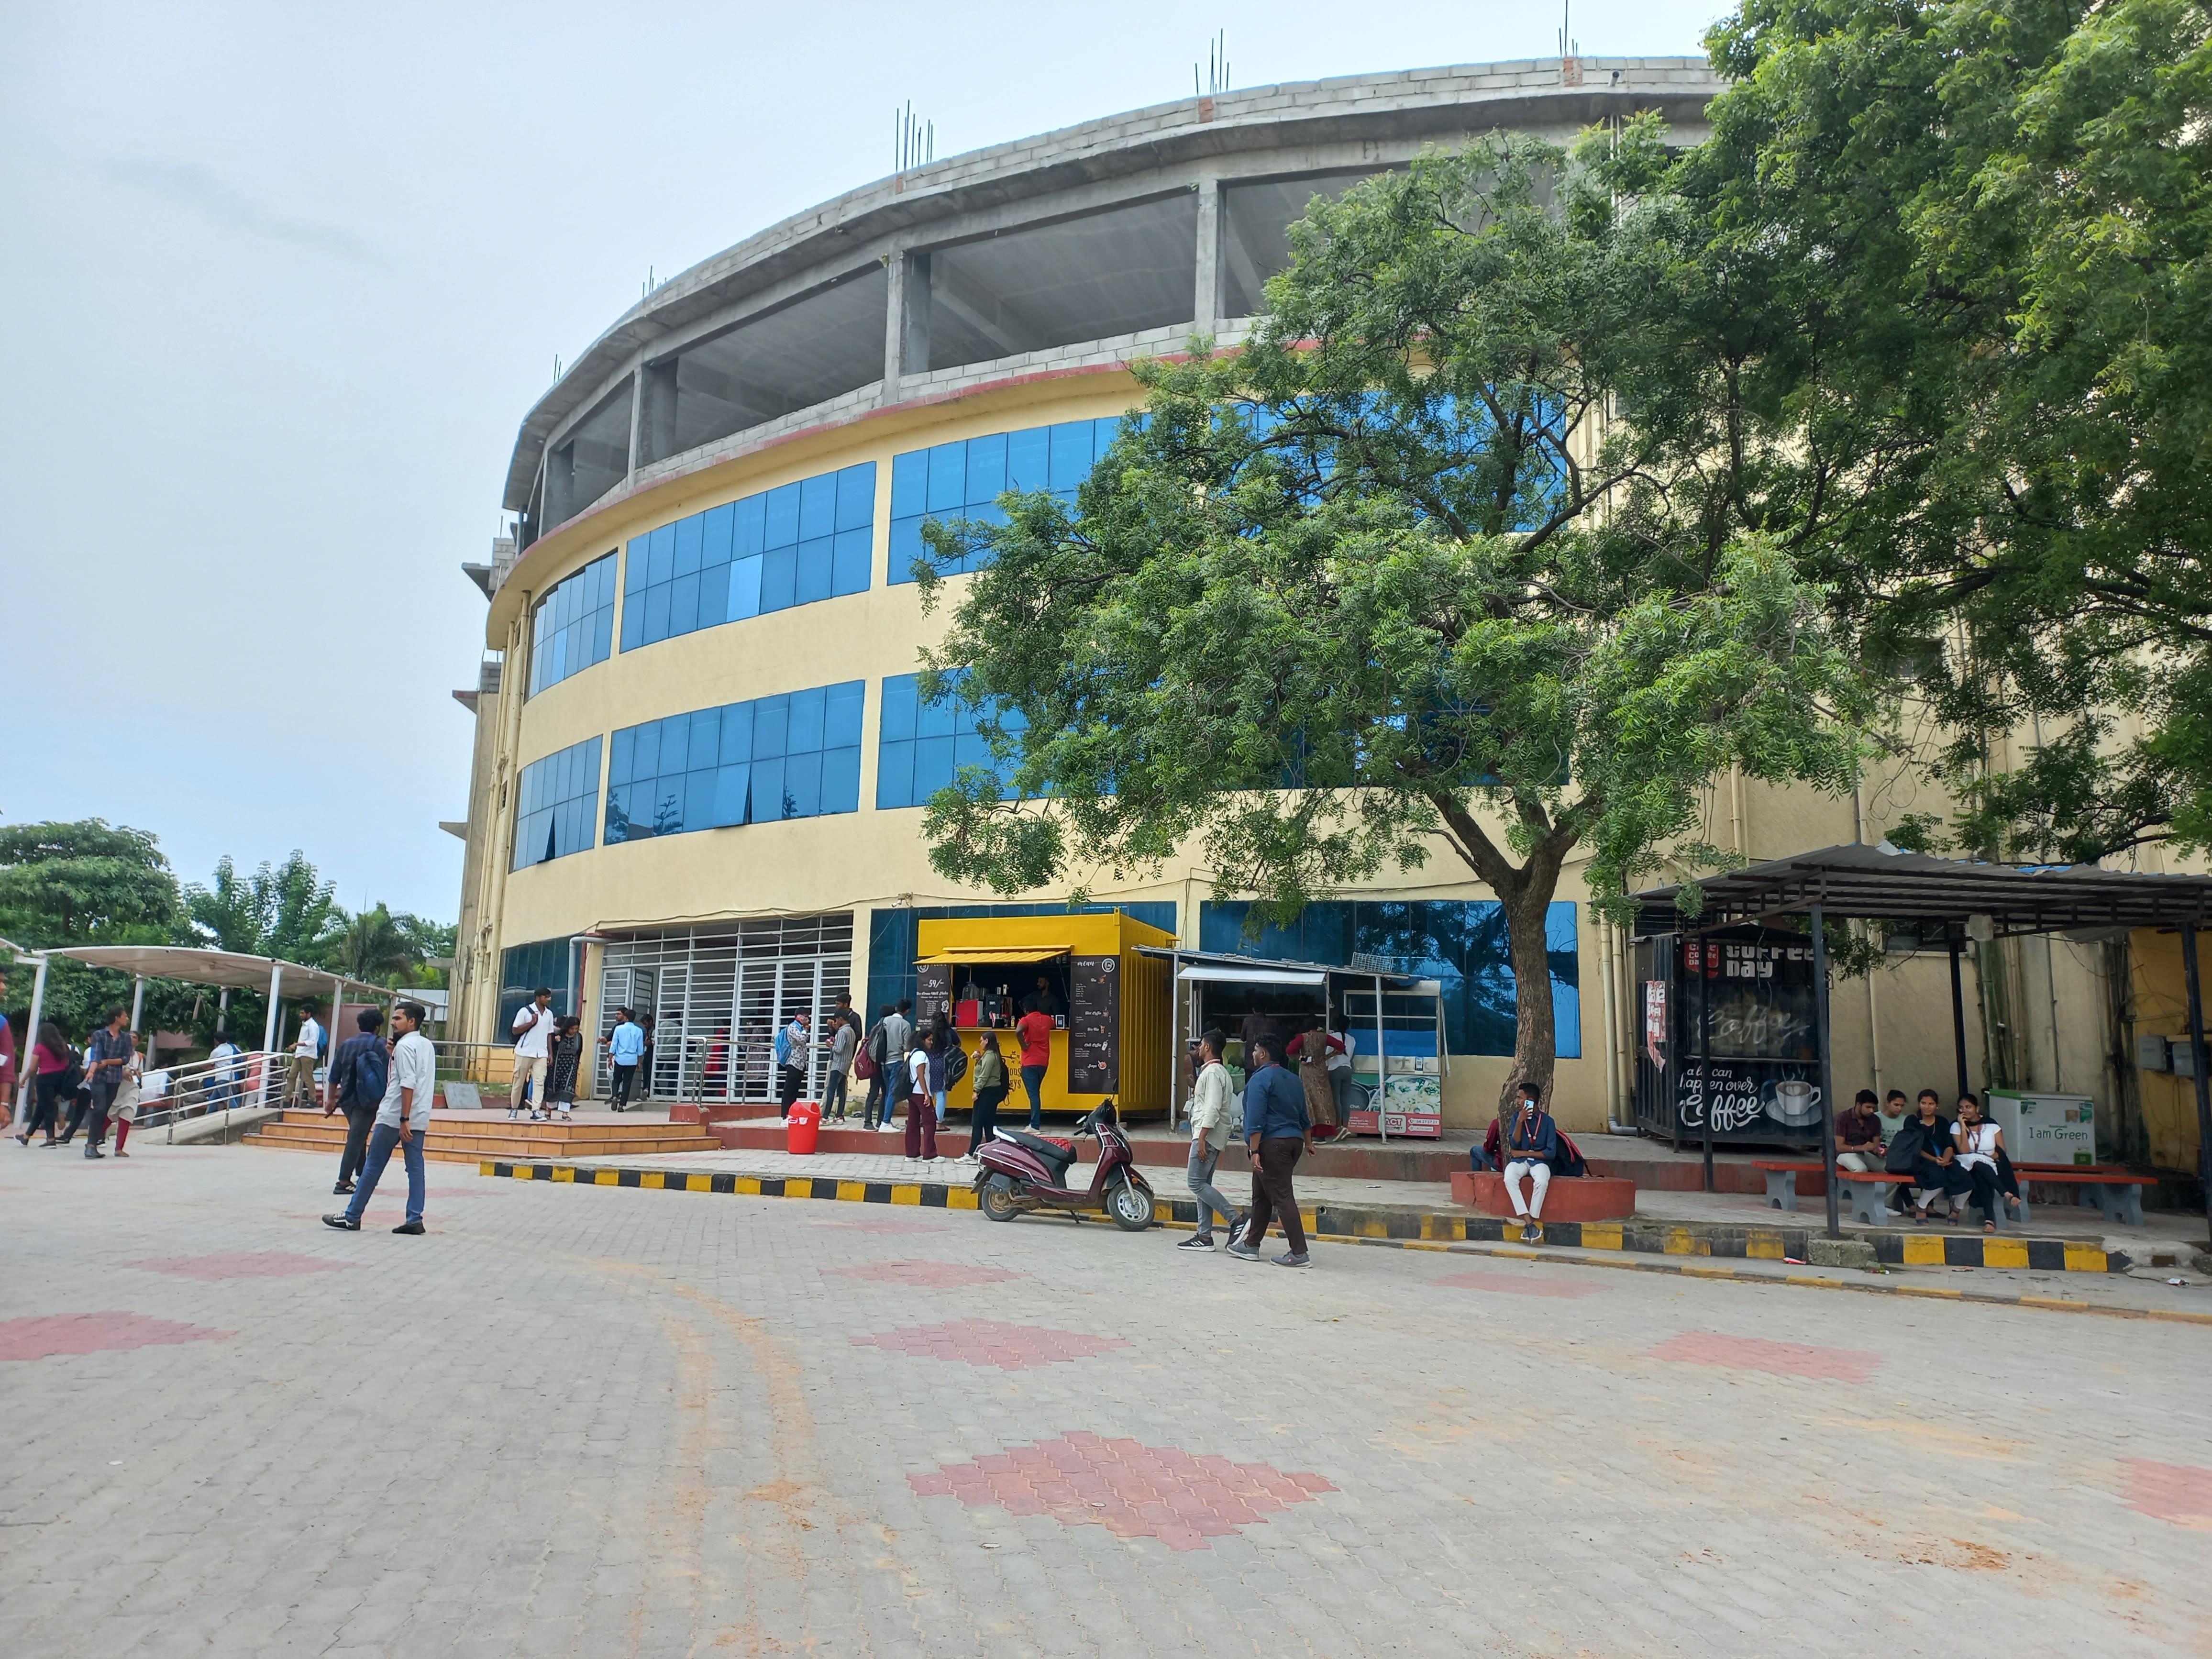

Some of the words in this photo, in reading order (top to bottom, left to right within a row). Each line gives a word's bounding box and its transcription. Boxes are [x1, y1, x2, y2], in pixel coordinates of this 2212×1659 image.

[1712, 1068, 1733, 1078] can
[1725, 1076, 1759, 1094] over
[2029, 1127, 2034, 1139] I
[2036, 1130, 2051, 1139] am
[2055, 1128, 2088, 1140] Green
